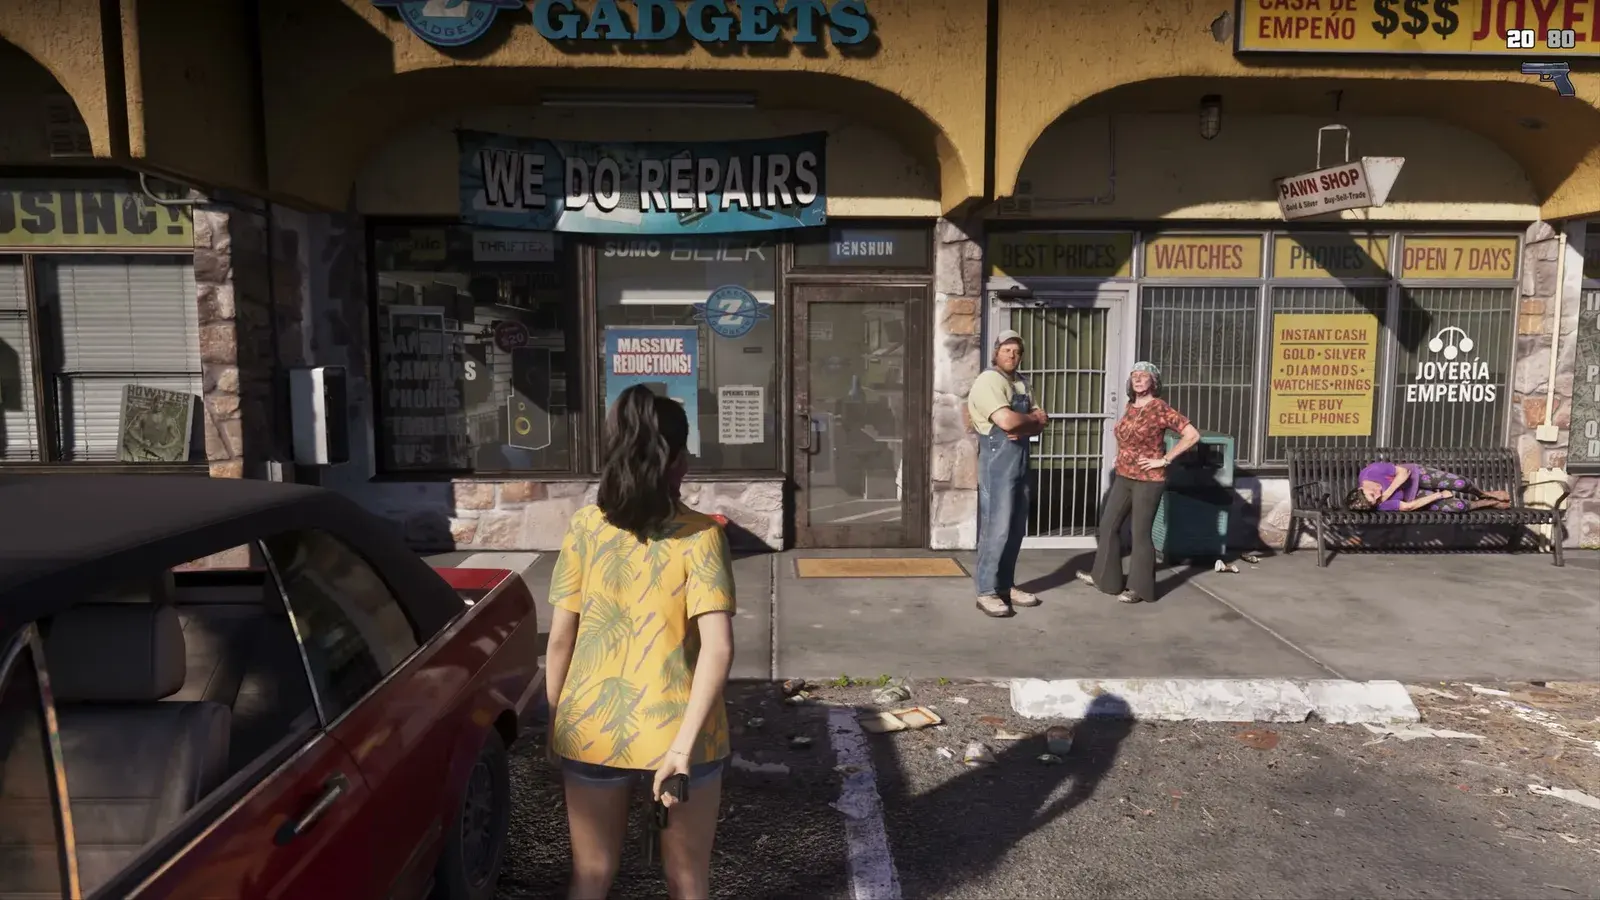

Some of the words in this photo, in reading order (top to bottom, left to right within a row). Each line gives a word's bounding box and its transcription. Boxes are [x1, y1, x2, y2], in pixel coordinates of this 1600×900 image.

[409, 9, 485, 36] GADGETS
[533, 0, 869, 43] GADGETS
[480, 149, 546, 208] WE
[564, 157, 620, 211] DO
[640, 151, 818, 210] REPAIRS
[1280, 178, 1319, 199] PAWN
[1320, 168, 1359, 191] SHOP
[1286, 202, 1298, 211] Gold
[1303, 200, 1318, 209] Silver
[1324, 191, 1366, 205] Buy-Sell-Trade
[604, 240, 661, 258] SUMO
[835, 241, 893, 256] TENSHUN
[1003, 243, 1048, 268] BEST
[1053, 243, 1116, 269] PRICES
[1155, 244, 1243, 270] WATCHES
[1290, 244, 1364, 270] PHONES
[1404, 247, 1446, 271] OPEN
[1453, 247, 1463, 271] 7
[1469, 247, 1511, 271] DAYS
[1281, 329, 1333, 341] INSTANT
[1334, 329, 1367, 341] CASH
[617, 338, 684, 353] MASSIVE
[1283, 348, 1315, 360] GOLD
[1324, 348, 1366, 360] SILVER
[613, 354, 692, 374] REDUCTIONS!
[1286, 364, 1358, 376] DIAMONDS
[1415, 356, 1490, 381] JOYERÍA
[128, 384, 190, 404] HOWITZER
[1407, 380, 1497, 403] EMPEÑOS
[1297, 399, 1316, 411] WE
[1318, 399, 1343, 411] BUY
[1279, 412, 1308, 424] CELL
[1311, 412, 1360, 424] PHONES
[392, 444, 433, 464] TV'S
